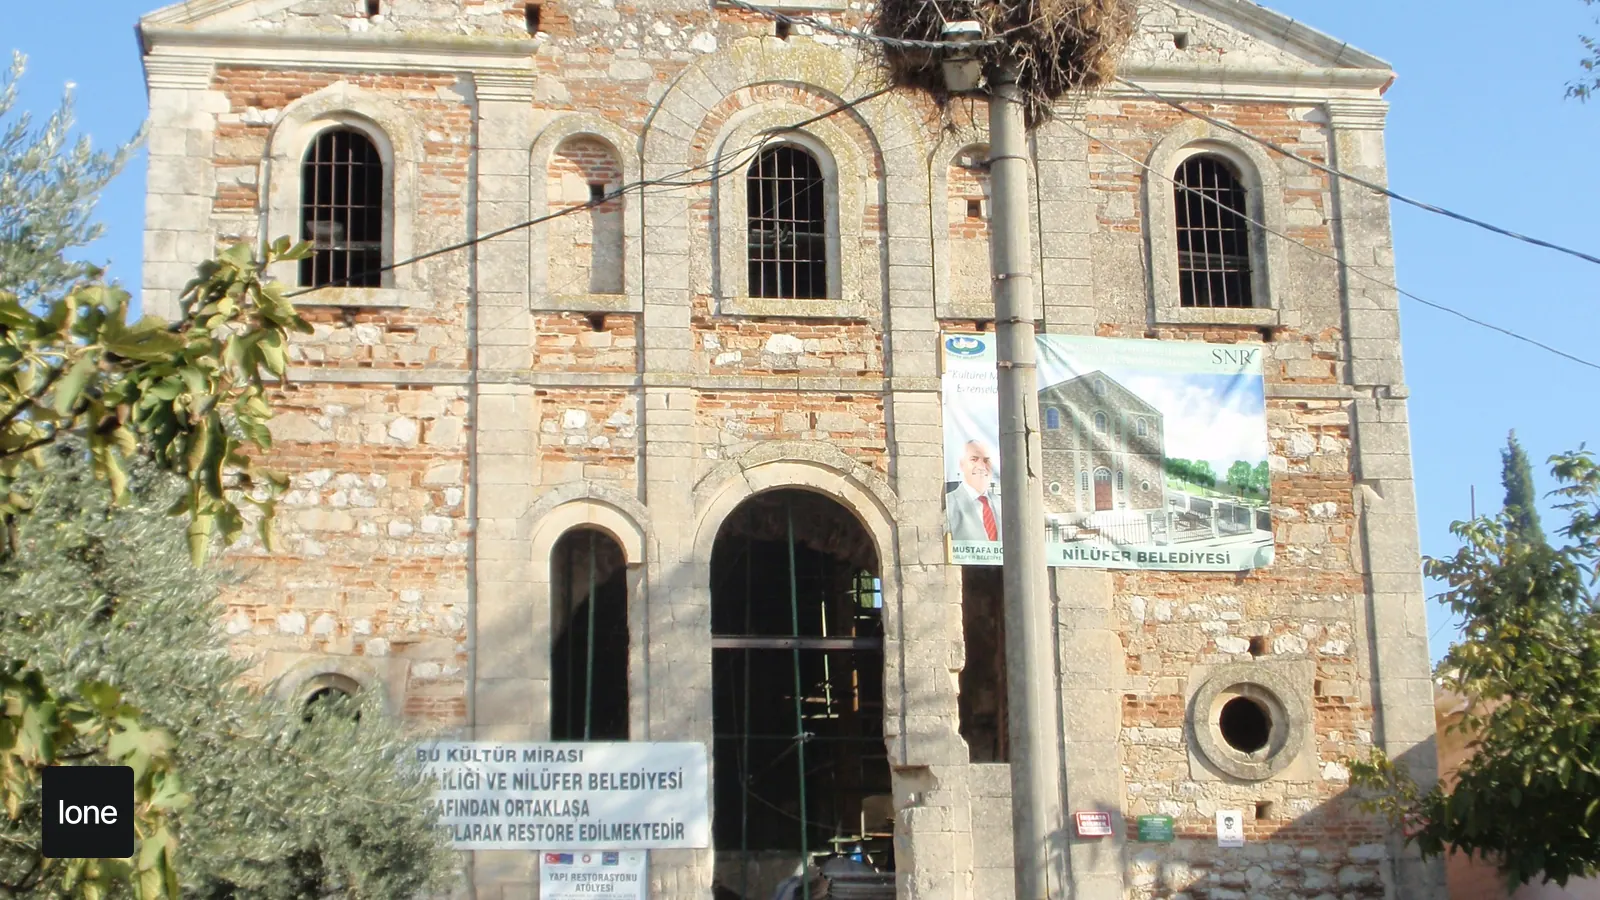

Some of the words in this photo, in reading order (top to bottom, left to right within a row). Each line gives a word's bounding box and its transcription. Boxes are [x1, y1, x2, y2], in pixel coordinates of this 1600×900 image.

[952, 546, 992, 554] MUSTAFA
[1062, 547, 1132, 562] NİLÜFER
[1136, 549, 1231, 565] BELEDİYESİ
[416, 749, 440, 763] BU
[447, 746, 517, 763] KÜLTÜR
[522, 746, 584, 763] MİRASI
[486, 772, 507, 790] VE
[512, 768, 583, 790] NİLÜFER
[588, 767, 683, 791] BELEDİYESİ
[504, 799, 590, 822] ORTAKLAŞA
[507, 823, 574, 841] RESTORE
[578, 818, 685, 841] EDİLMEKTEDİR
[549, 872, 568, 882] YAPI
[570, 872, 638, 882] RESTORASYONU
